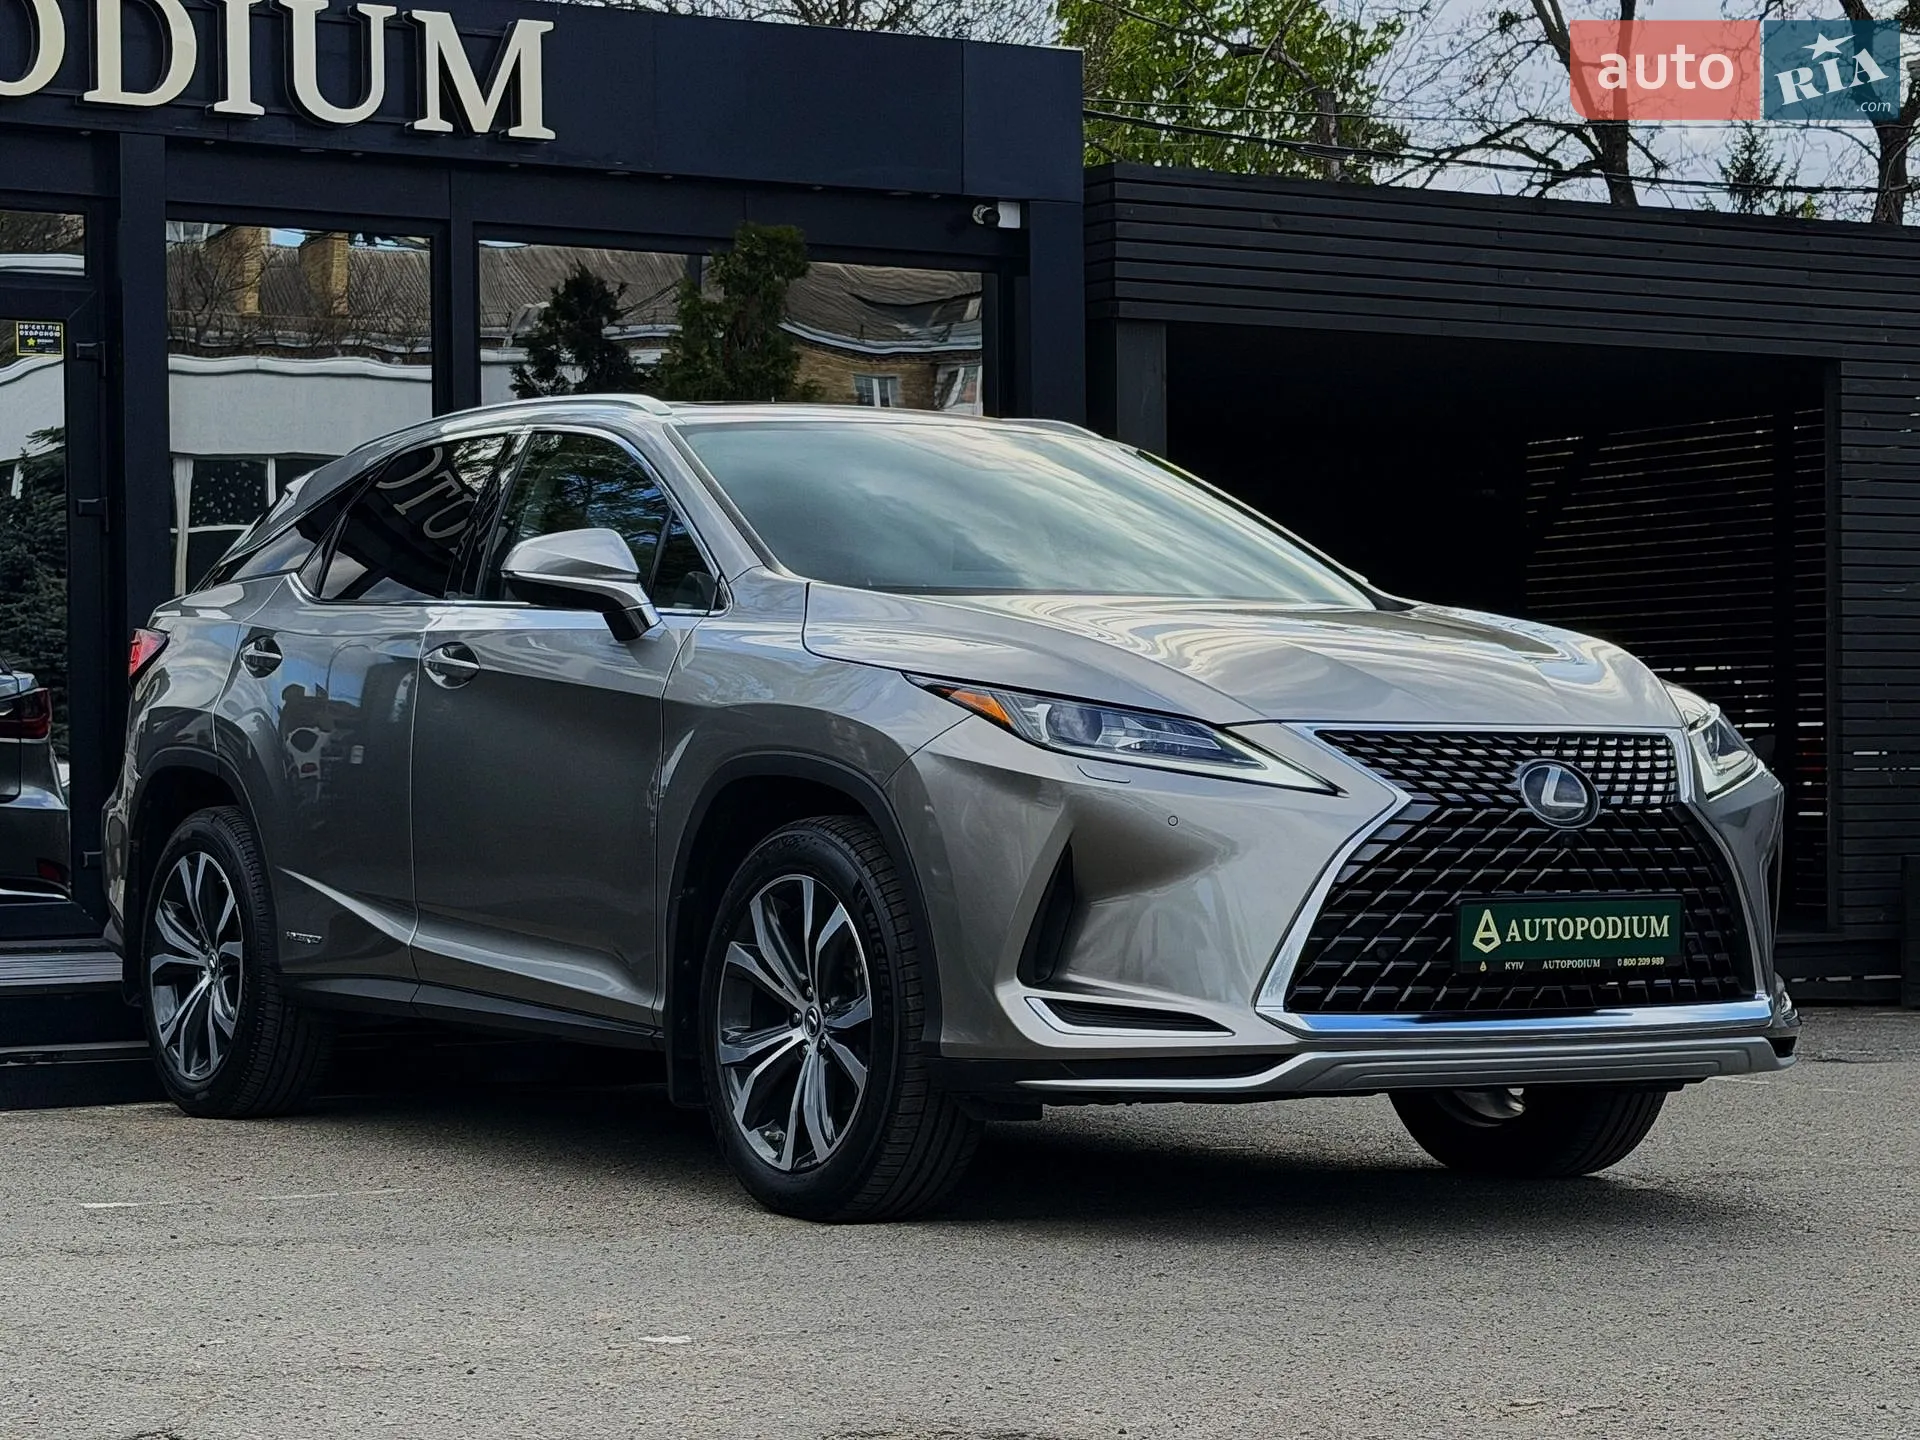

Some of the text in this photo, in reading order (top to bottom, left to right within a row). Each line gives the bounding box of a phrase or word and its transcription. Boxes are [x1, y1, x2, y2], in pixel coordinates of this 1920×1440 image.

[1505, 915, 1670, 942] AUTOPODIUM
[1504, 961, 1525, 971] KYIV
[1542, 958, 1600, 970] AUTOPODIUM
